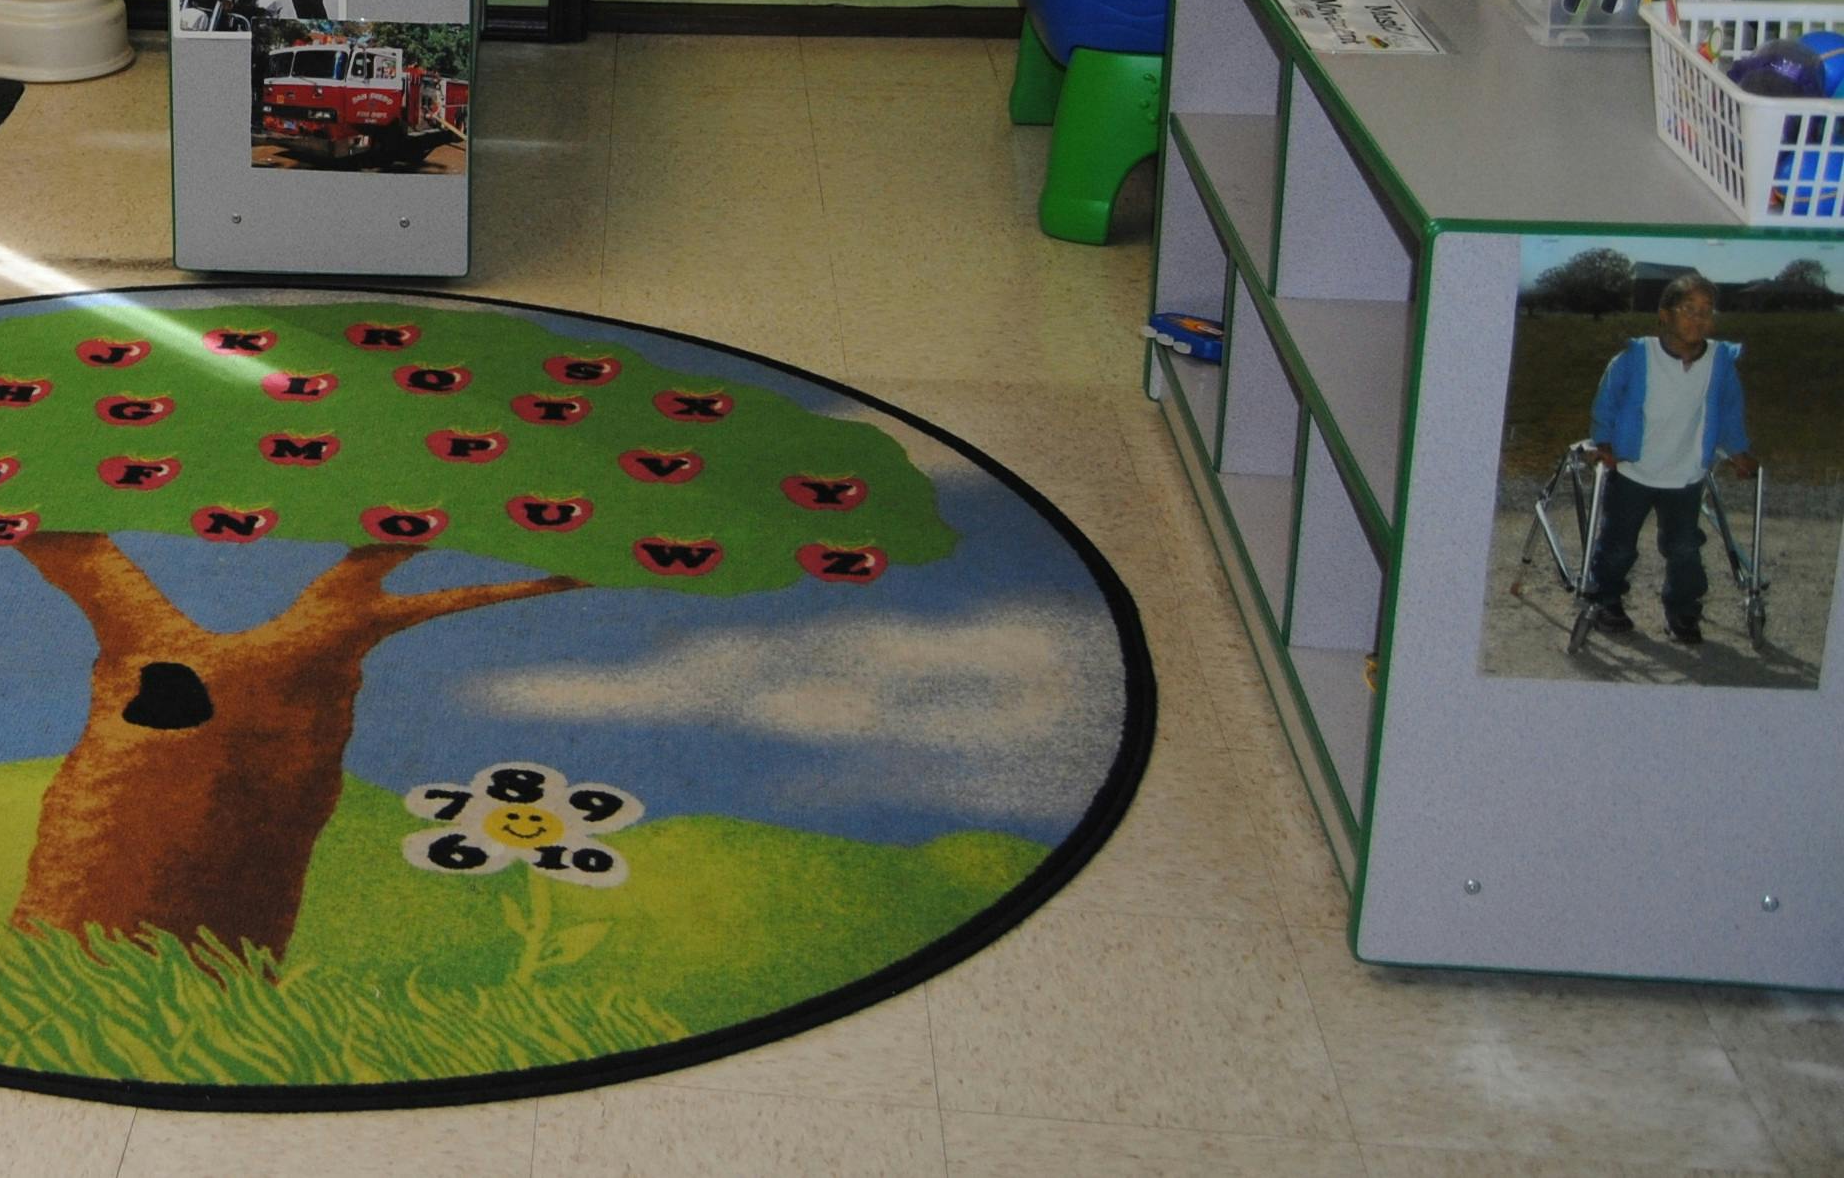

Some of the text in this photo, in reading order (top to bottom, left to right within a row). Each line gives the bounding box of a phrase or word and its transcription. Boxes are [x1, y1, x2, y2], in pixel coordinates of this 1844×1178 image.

[223, 334, 260, 350] K
[362, 329, 403, 346] R
[91, 348, 127, 364] J
[409, 370, 455, 391] Q
[566, 362, 603, 380] S
[288, 379, 318, 395] L
[110, 403, 152, 420] G
[535, 402, 576, 420] T
[675, 398, 724, 419] X
[272, 440, 326, 459] M
[450, 439, 490, 457] P
[119, 466, 163, 484] F
[637, 458, 688, 476] V
[801, 482, 852, 504] Y
[525, 503, 575, 525] U
[207, 514, 258, 535] N
[380, 516, 429, 536] O
[642, 544, 716, 568] W
[822, 552, 870, 576] Z
[487, 769, 545, 803] 8
[425, 790, 472, 820] 7
[570, 791, 623, 822] 9
[428, 834, 487, 869] 6
[535, 846, 613, 872] 10
